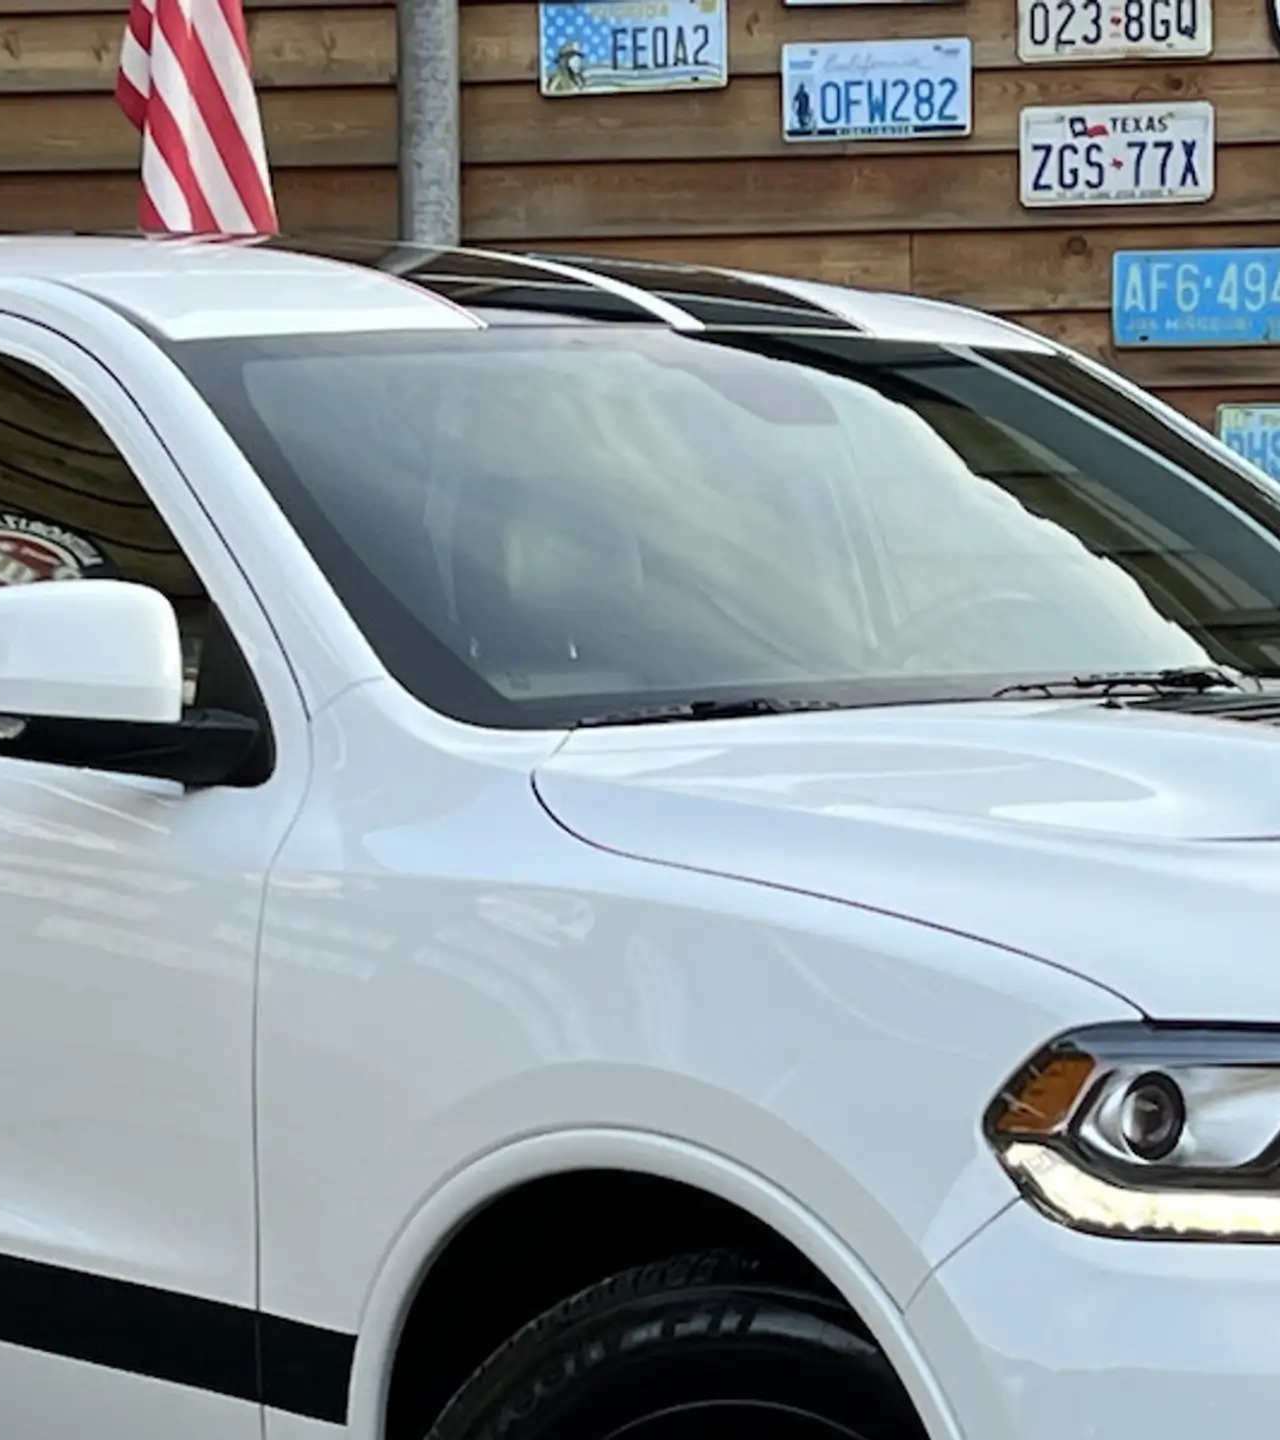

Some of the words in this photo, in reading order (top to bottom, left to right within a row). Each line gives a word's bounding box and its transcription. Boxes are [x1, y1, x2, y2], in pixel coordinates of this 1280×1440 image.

[1109, 116, 1169, 134] TEXAS
[1032, 143, 1104, 191] ZGS
[1126, 140, 1198, 188] 77X
